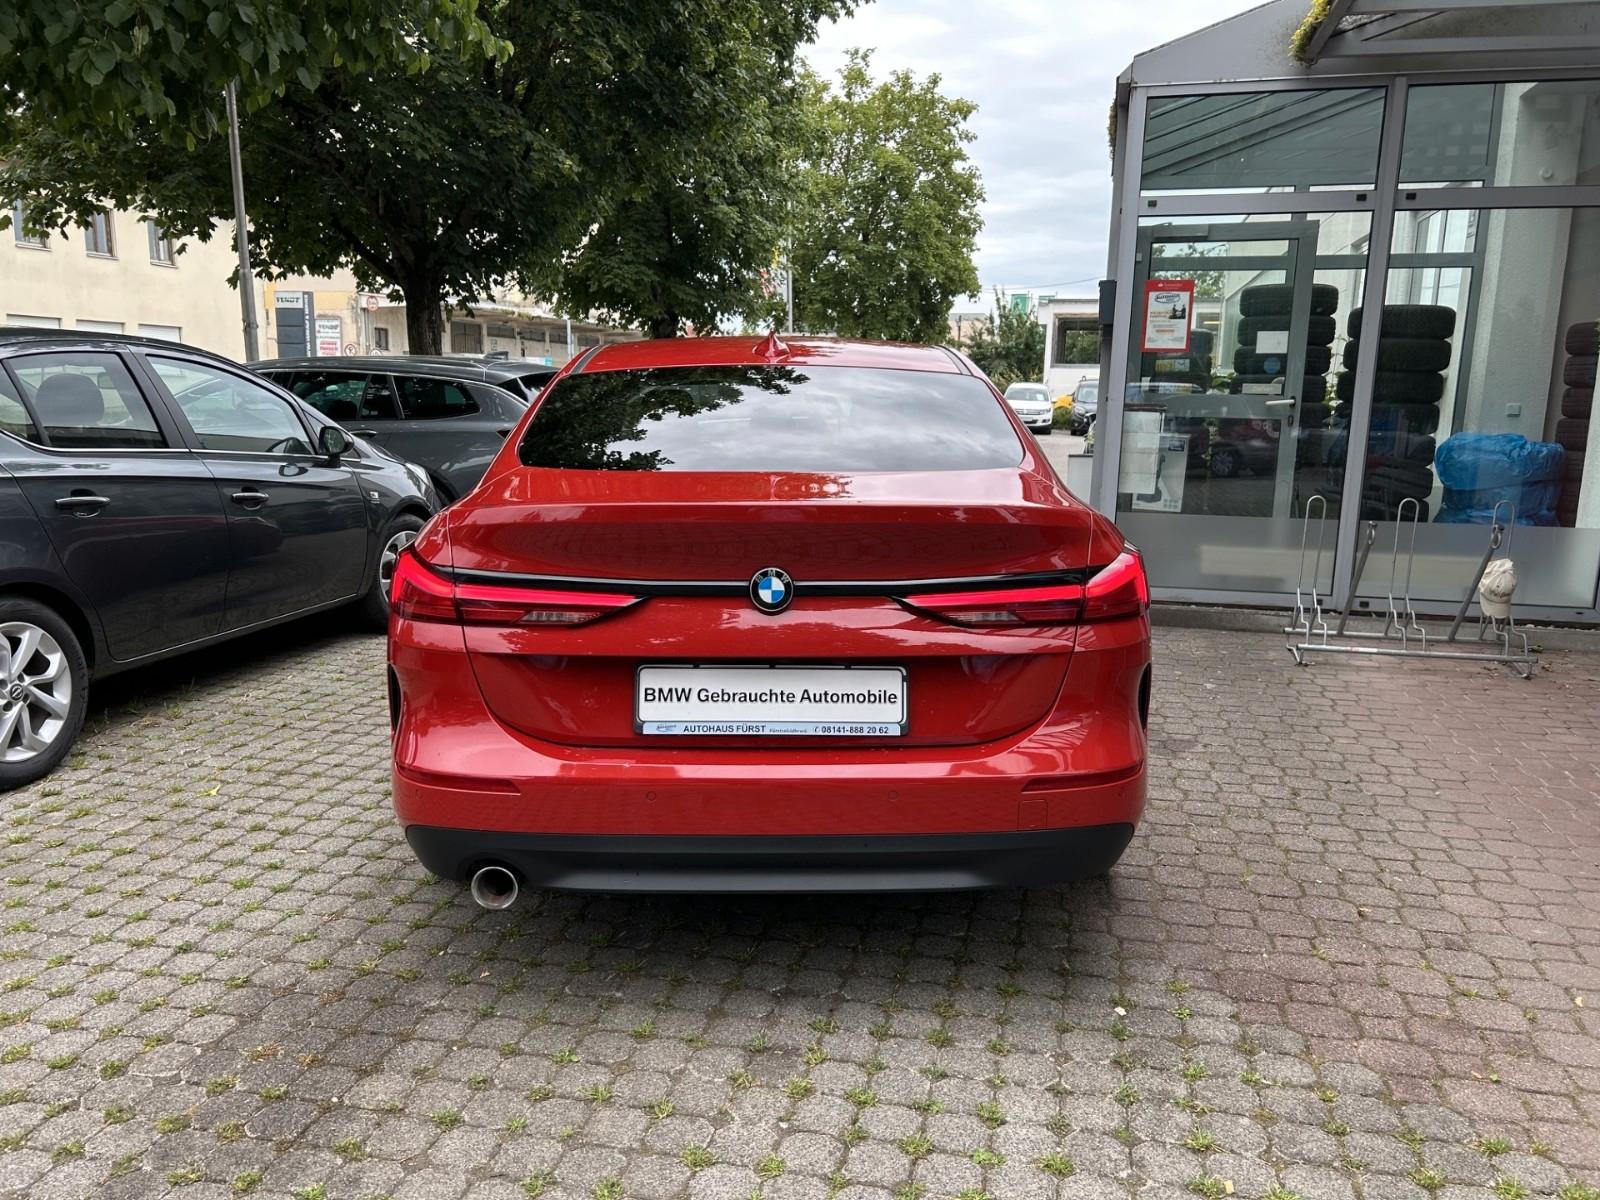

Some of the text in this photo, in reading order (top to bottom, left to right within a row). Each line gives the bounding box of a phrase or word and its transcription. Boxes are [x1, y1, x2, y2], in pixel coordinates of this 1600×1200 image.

[755, 569, 791, 584] BMW
[643, 687, 898, 704] BMW Gebrauchte Automobile
[683, 724, 735, 733] AUTOHAUS
[736, 723, 767, 733] FÜRST
[821, 725, 864, 734] 08141-888
[866, 726, 877, 734] 20
[878, 726, 889, 734] 62
